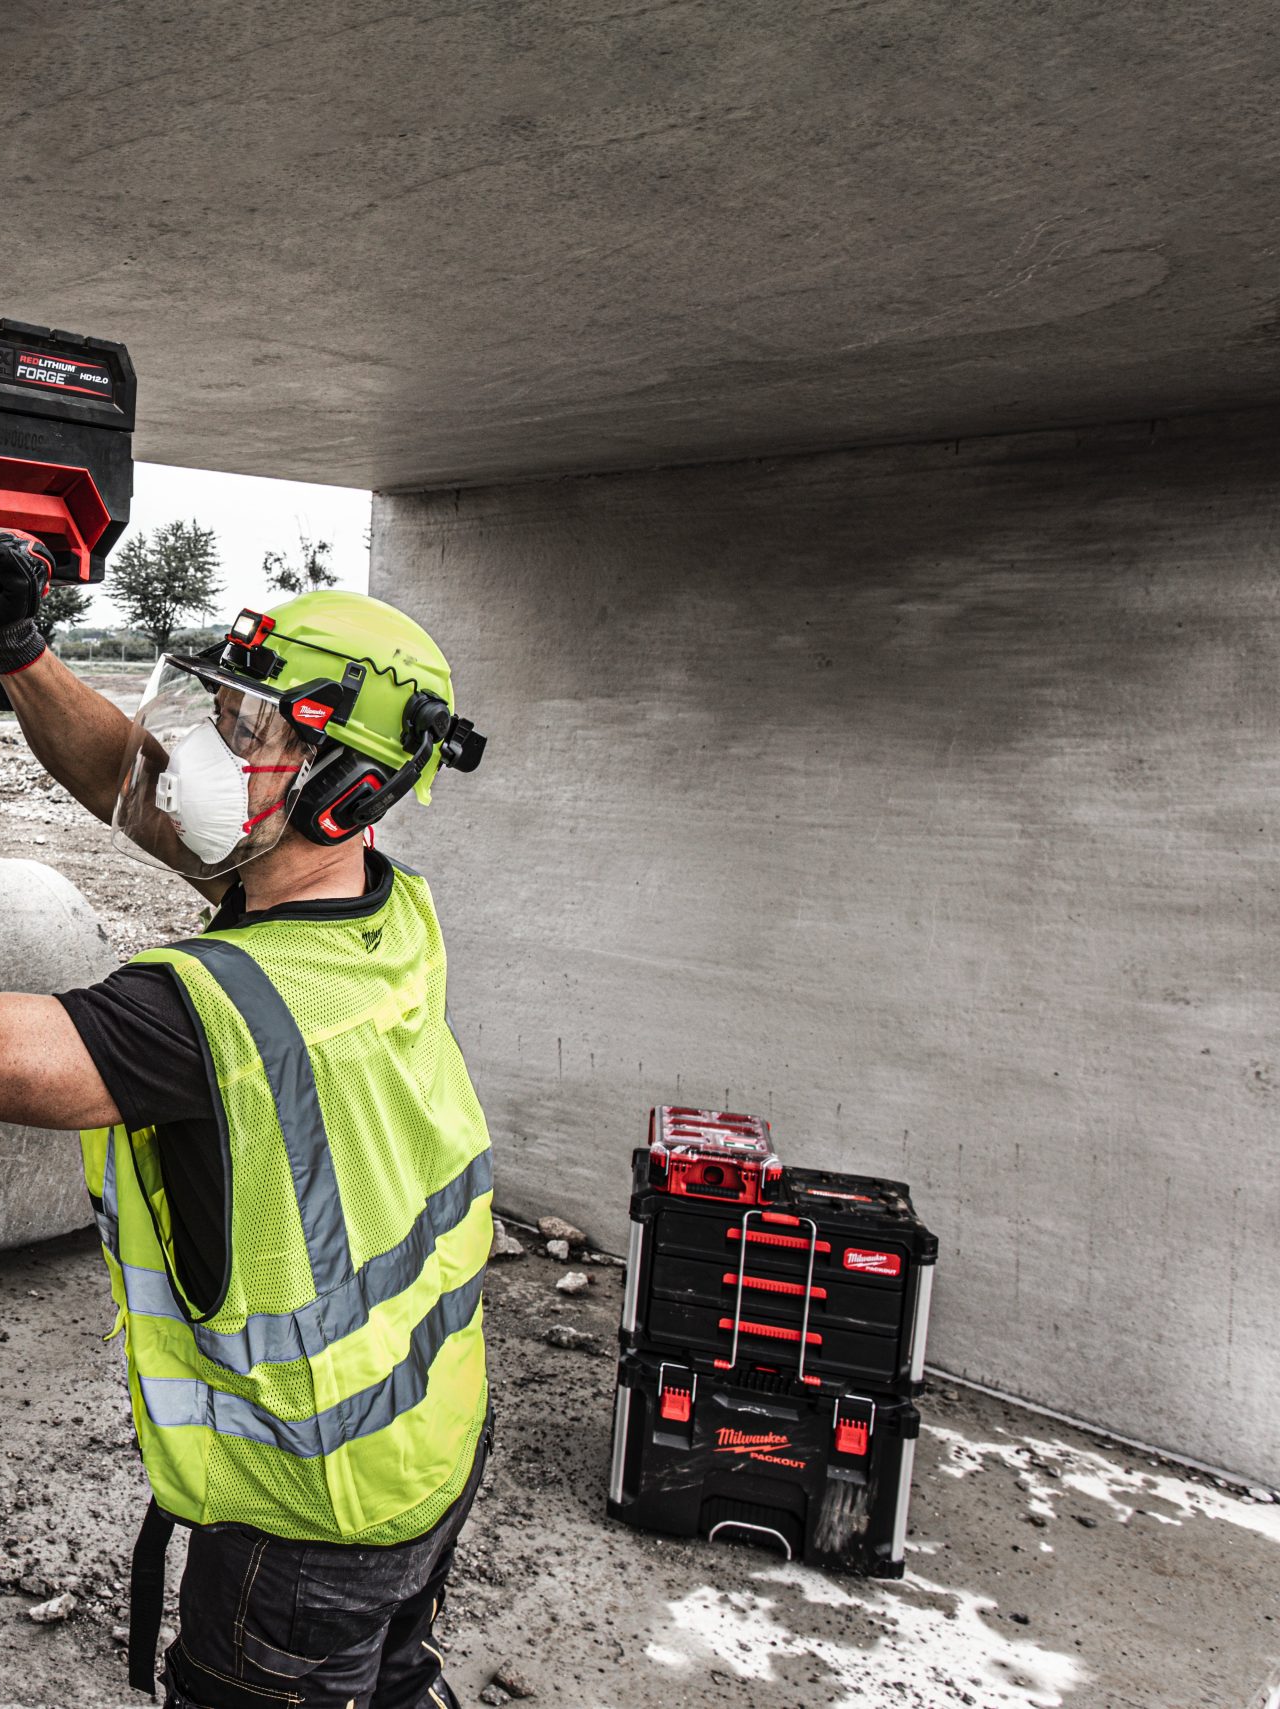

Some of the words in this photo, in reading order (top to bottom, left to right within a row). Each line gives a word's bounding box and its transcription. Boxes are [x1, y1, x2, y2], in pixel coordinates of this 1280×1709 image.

[19, 355, 76, 372] REDLITHIUM
[16, 366, 66, 385] FORGE
[79, 372, 109, 385] HD12.0
[715, 1427, 788, 1446] Milwaukee
[750, 1452, 806, 1469] PACKOUT
